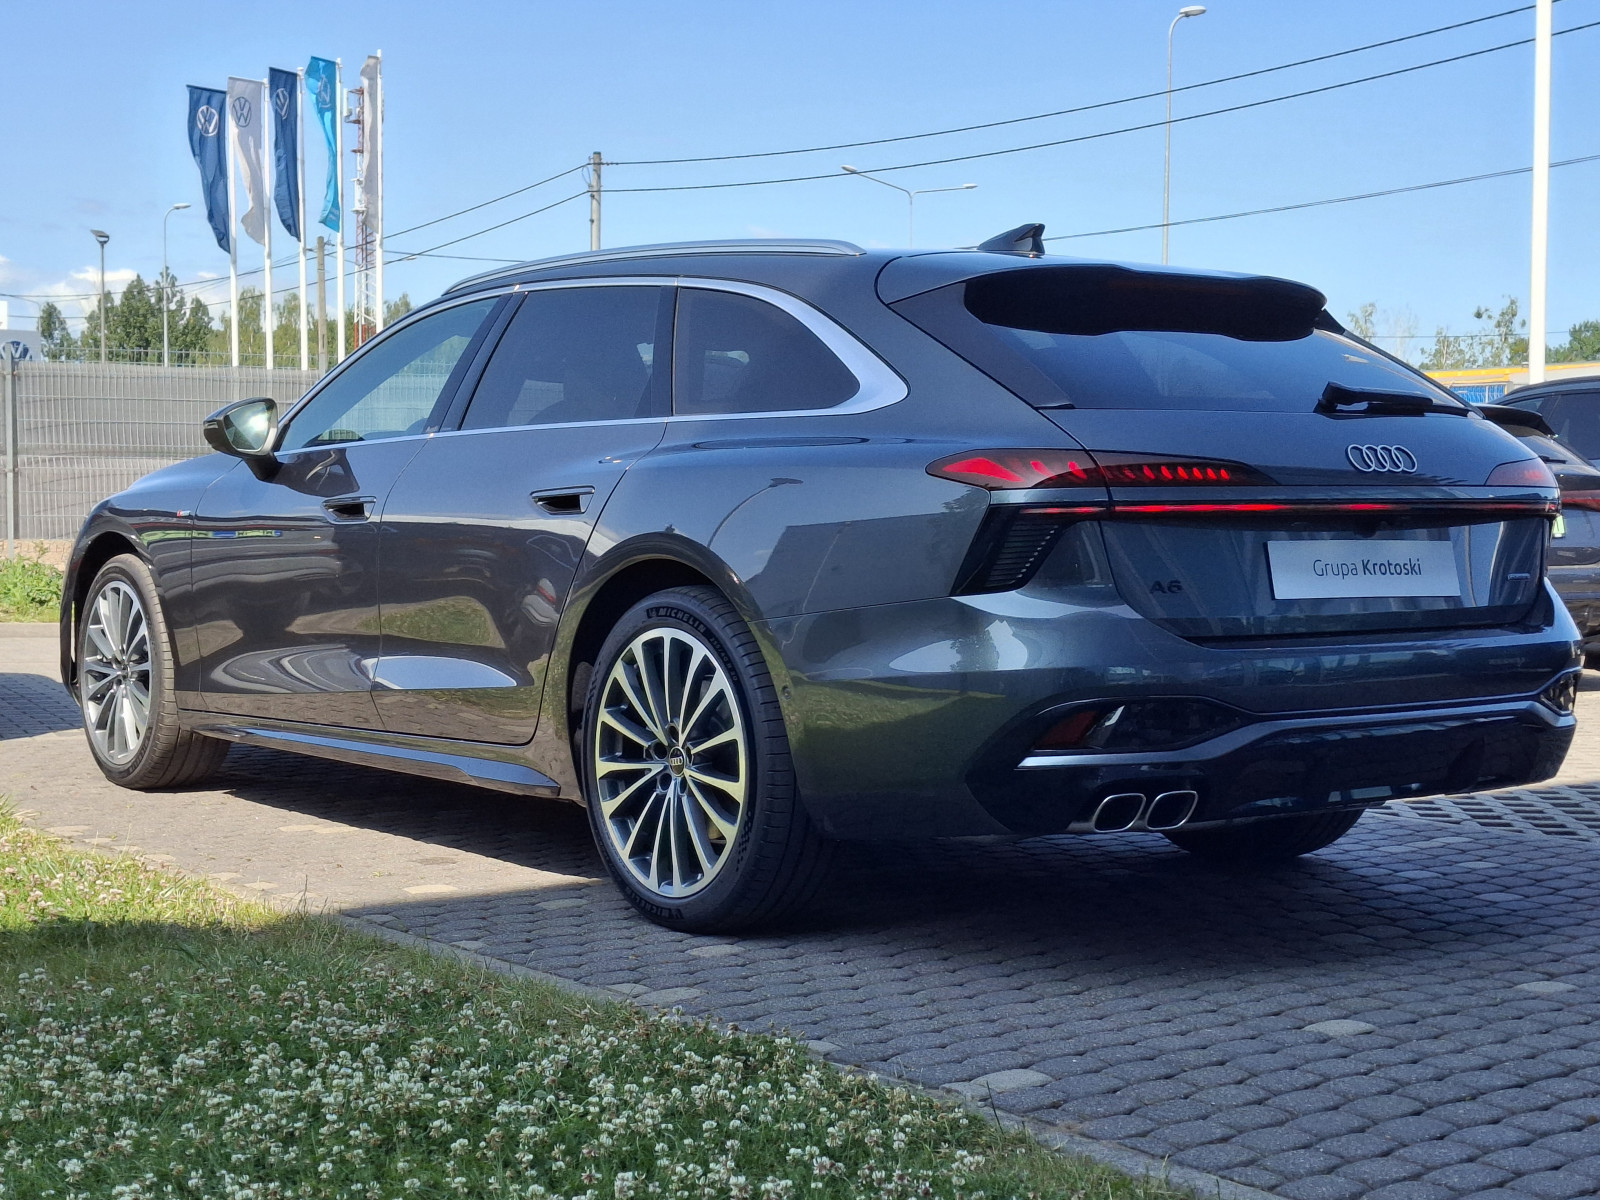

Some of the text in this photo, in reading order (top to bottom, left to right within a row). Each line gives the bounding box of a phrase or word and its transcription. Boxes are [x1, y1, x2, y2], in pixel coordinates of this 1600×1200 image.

[1313, 558, 1422, 579] Grupa Krotoski
[1149, 579, 1183, 594] A6
[658, 607, 707, 634] MICHELIN
